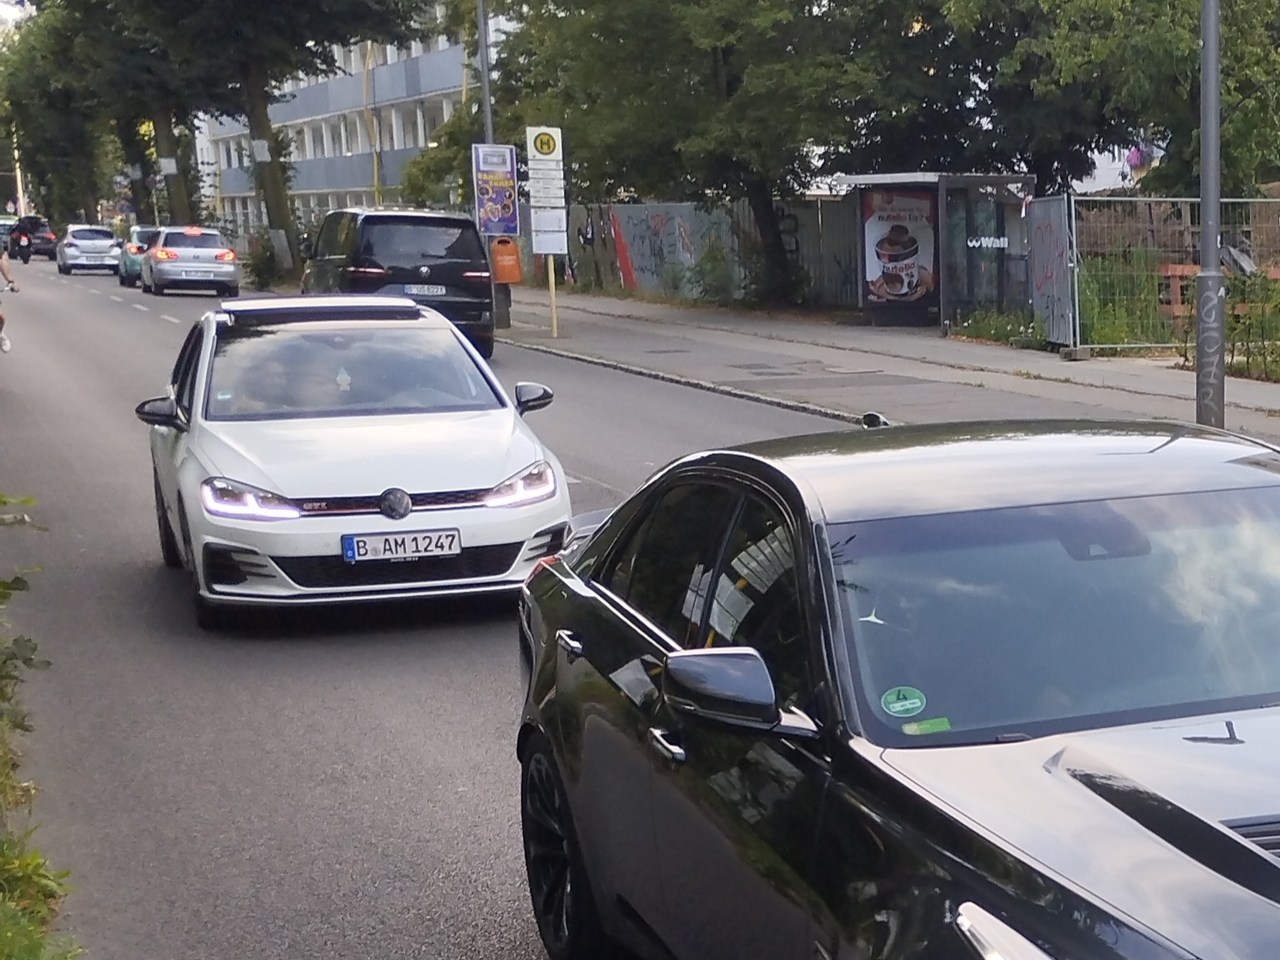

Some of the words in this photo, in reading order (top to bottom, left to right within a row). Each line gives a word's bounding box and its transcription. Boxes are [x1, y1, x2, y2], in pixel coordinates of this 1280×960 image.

[540, 138, 551, 151] H
[981, 236, 1009, 248] Wall
[356, 540, 368, 557] B
[382, 537, 406, 555] AM
[411, 533, 456, 553] 1247
[896, 689, 908, 701] 4
